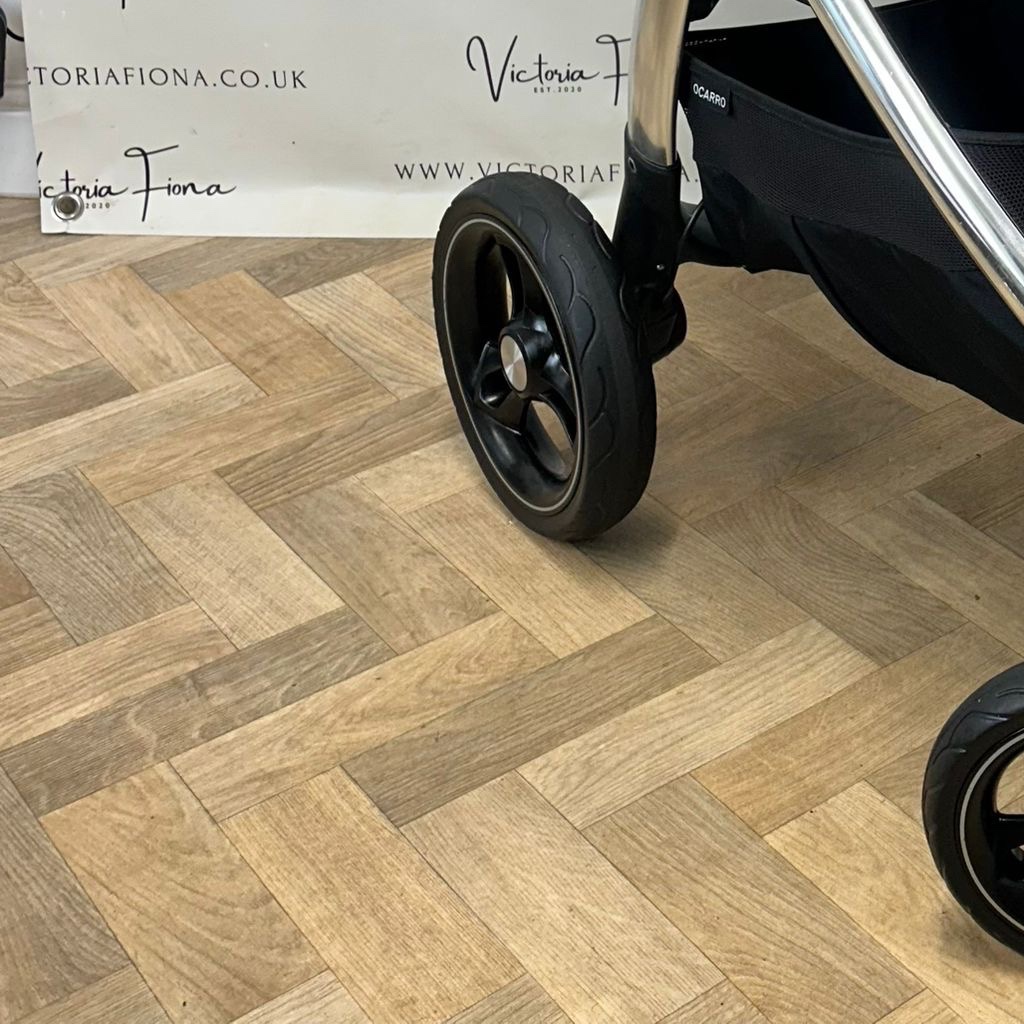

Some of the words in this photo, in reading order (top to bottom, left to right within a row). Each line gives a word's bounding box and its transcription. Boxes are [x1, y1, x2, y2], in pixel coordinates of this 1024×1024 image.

[27, 66, 307, 89] TORIAFIONA.CO.UK
[467, 35, 600, 102] Victoria
[693, 83, 727, 108] OCARRO
[124, 144, 237, 222] Fiona
